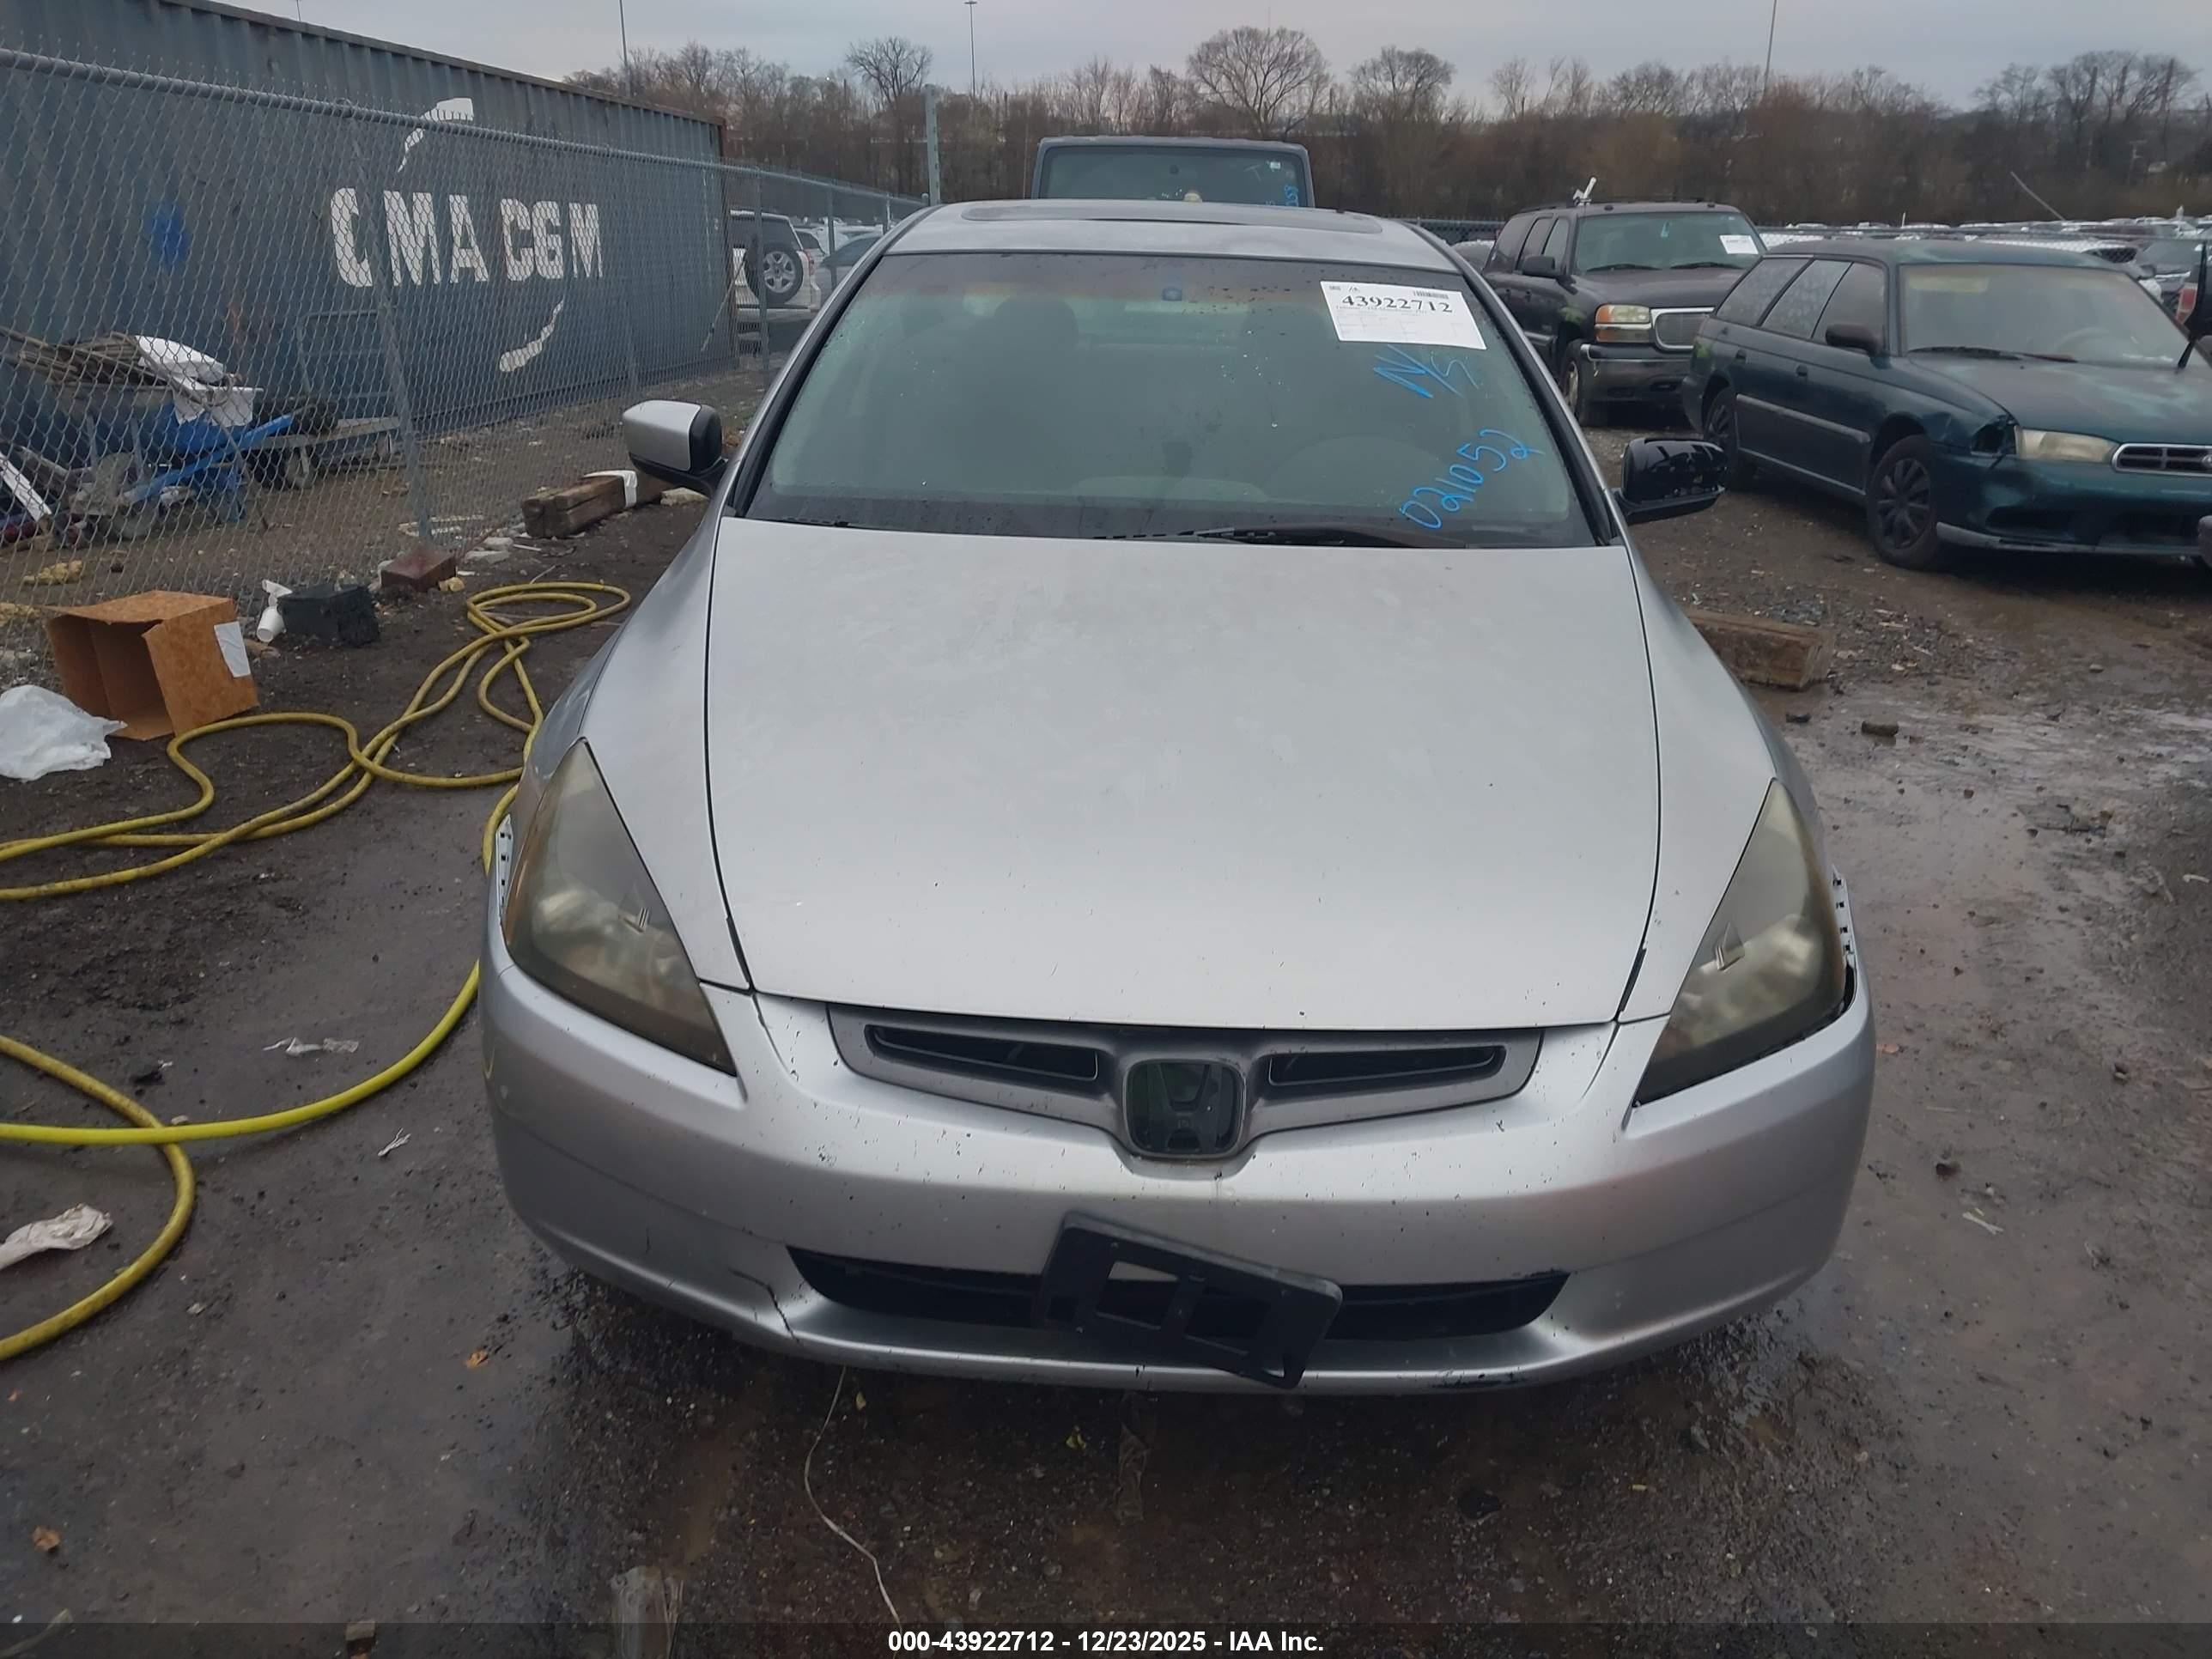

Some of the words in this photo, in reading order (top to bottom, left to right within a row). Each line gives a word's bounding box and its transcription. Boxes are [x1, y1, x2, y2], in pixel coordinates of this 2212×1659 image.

[330, 187, 489, 287] CMA
[500, 198, 604, 280] CGM
[1342, 295, 1454, 313] 43922712
